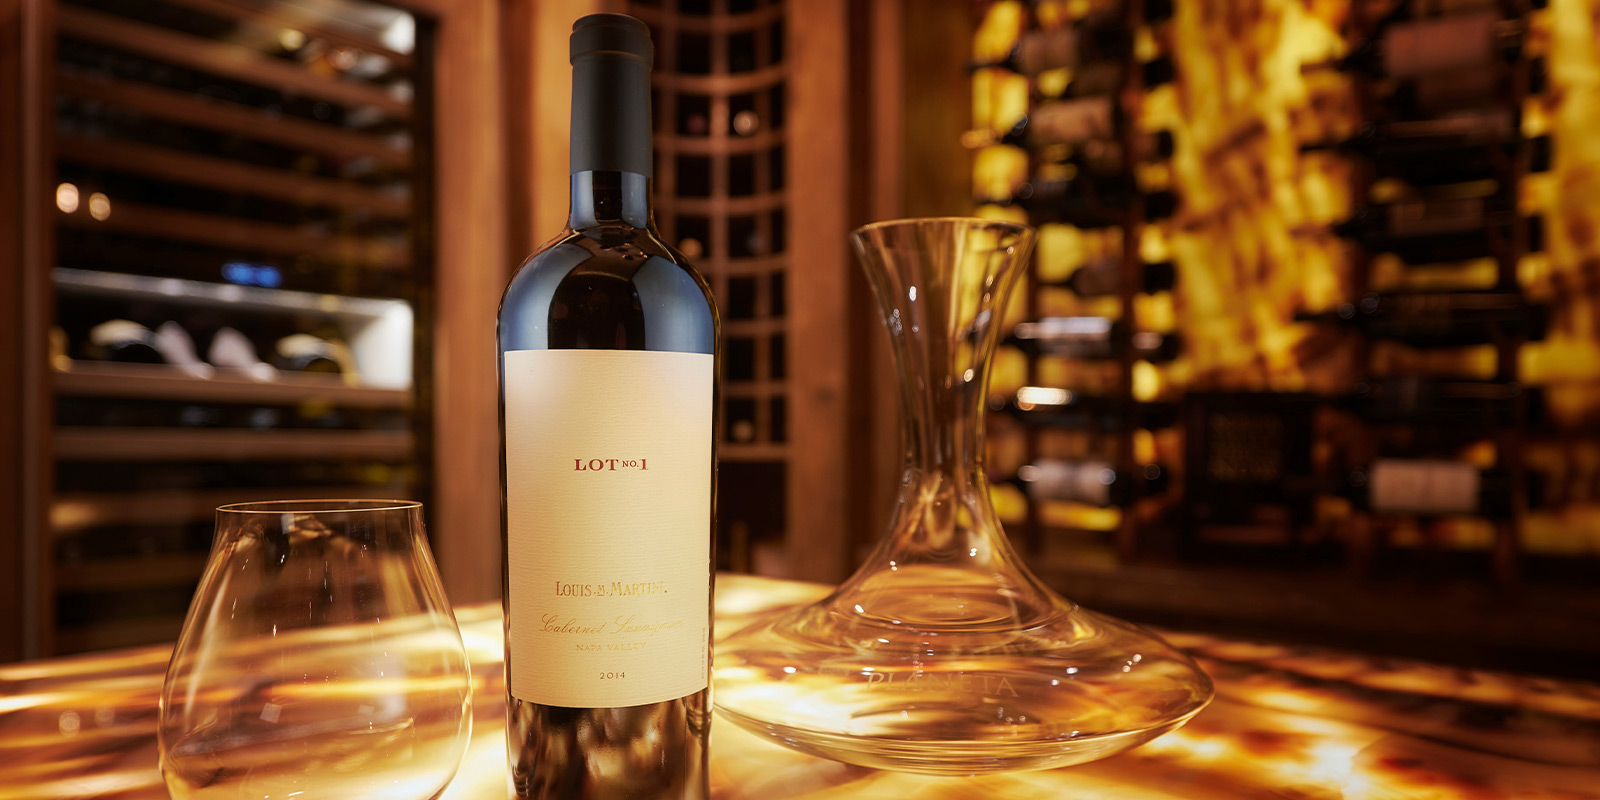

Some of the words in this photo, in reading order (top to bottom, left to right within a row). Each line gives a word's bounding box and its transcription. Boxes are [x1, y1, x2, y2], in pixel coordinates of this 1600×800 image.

[574, 459, 619, 471] LOT
[556, 581, 592, 597] LOUIS
[539, 613, 607, 634] Cabernet
[576, 644, 603, 652] NAPA
[607, 642, 647, 651] VALLEY
[599, 672, 625, 680] 2014
[865, 672, 1020, 698] PLANETA
